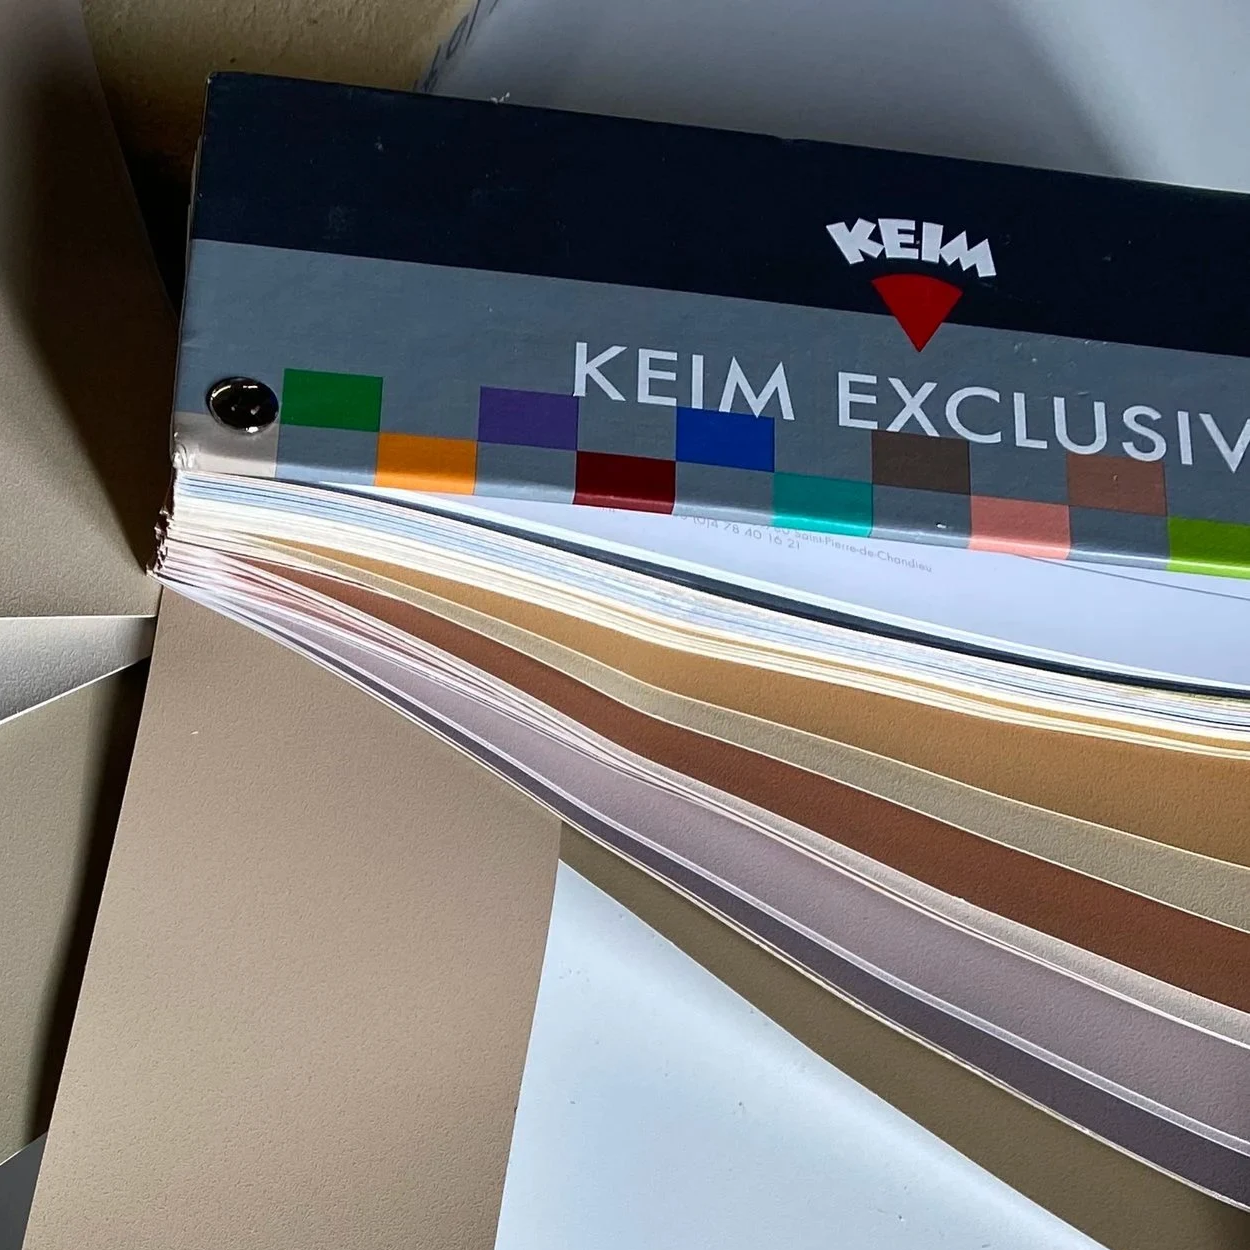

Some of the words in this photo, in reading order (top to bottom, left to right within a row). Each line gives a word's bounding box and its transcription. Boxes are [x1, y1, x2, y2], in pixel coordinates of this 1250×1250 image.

[826, 219, 996, 277] KEIM
[573, 342, 794, 420] KEIM
[839, 372, 1250, 472] EXCLUSIV
